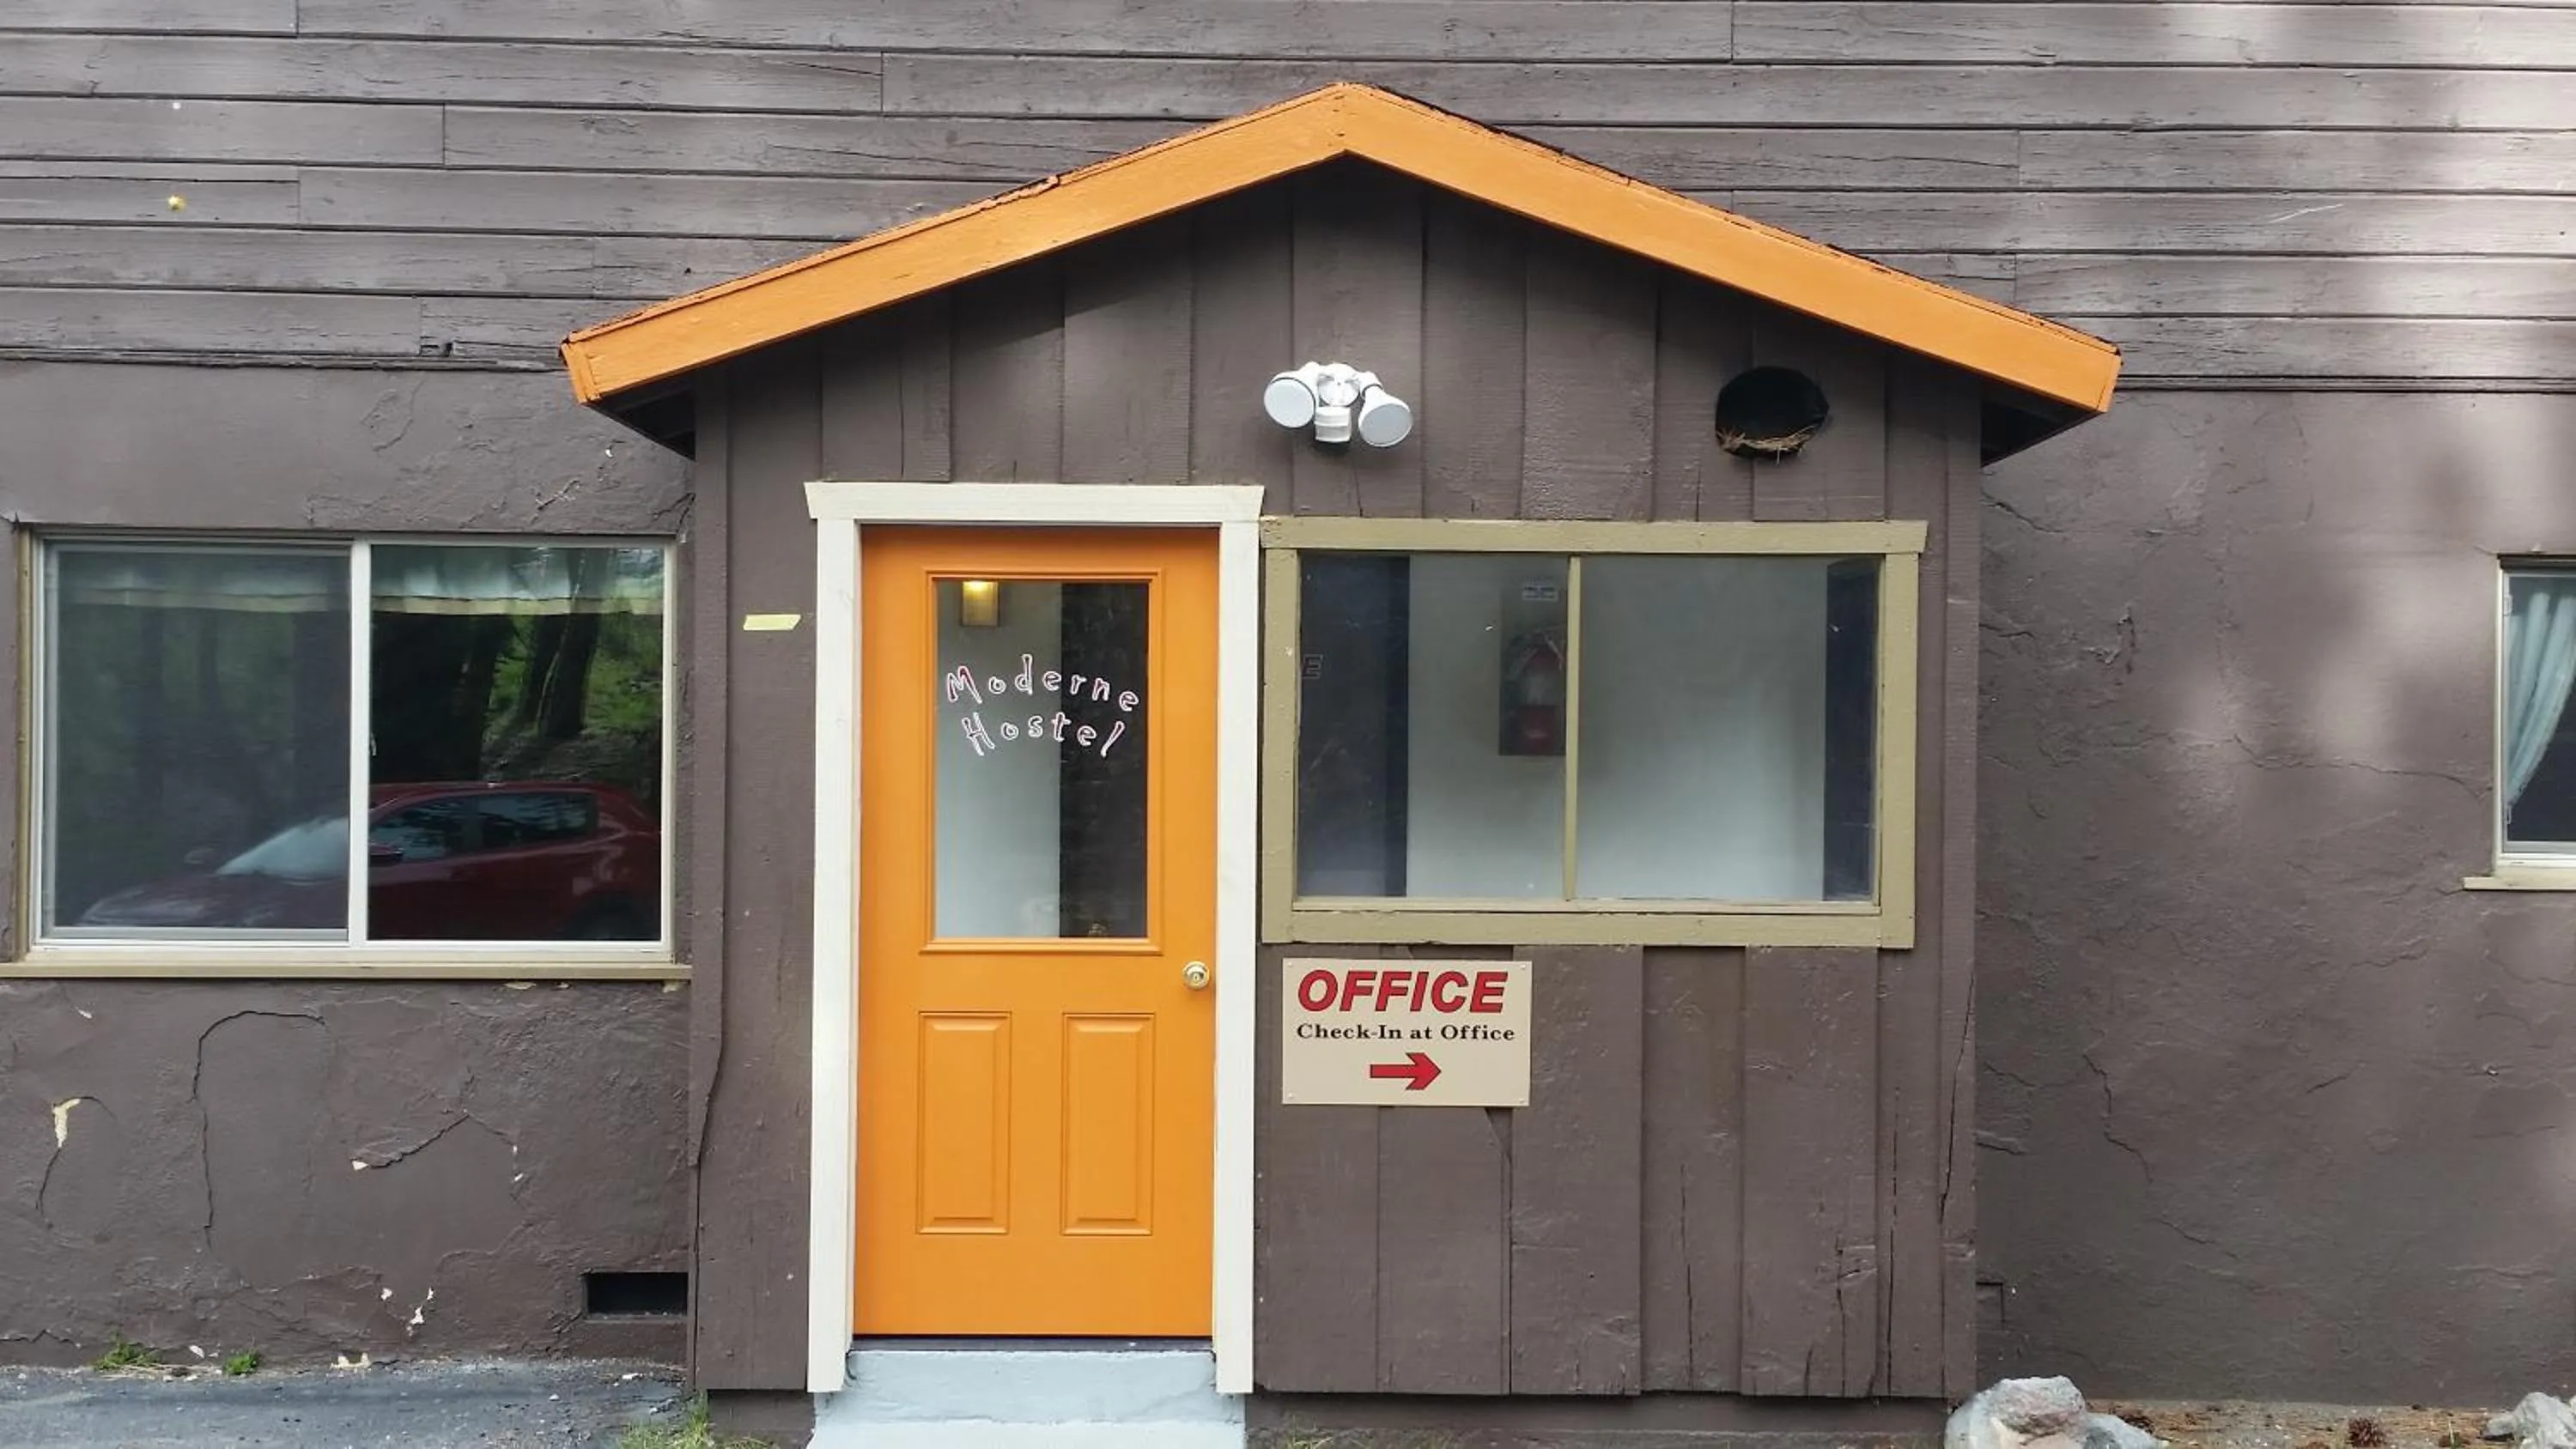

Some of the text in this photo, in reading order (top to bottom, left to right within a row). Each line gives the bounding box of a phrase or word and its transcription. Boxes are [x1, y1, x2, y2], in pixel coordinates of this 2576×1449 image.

[946, 653, 1139, 712] Moderne
[962, 711, 1126, 757] Hostel
[1297, 969, 1509, 1014] OFFICE
[1297, 1022, 1516, 1041] Check-In at Office
